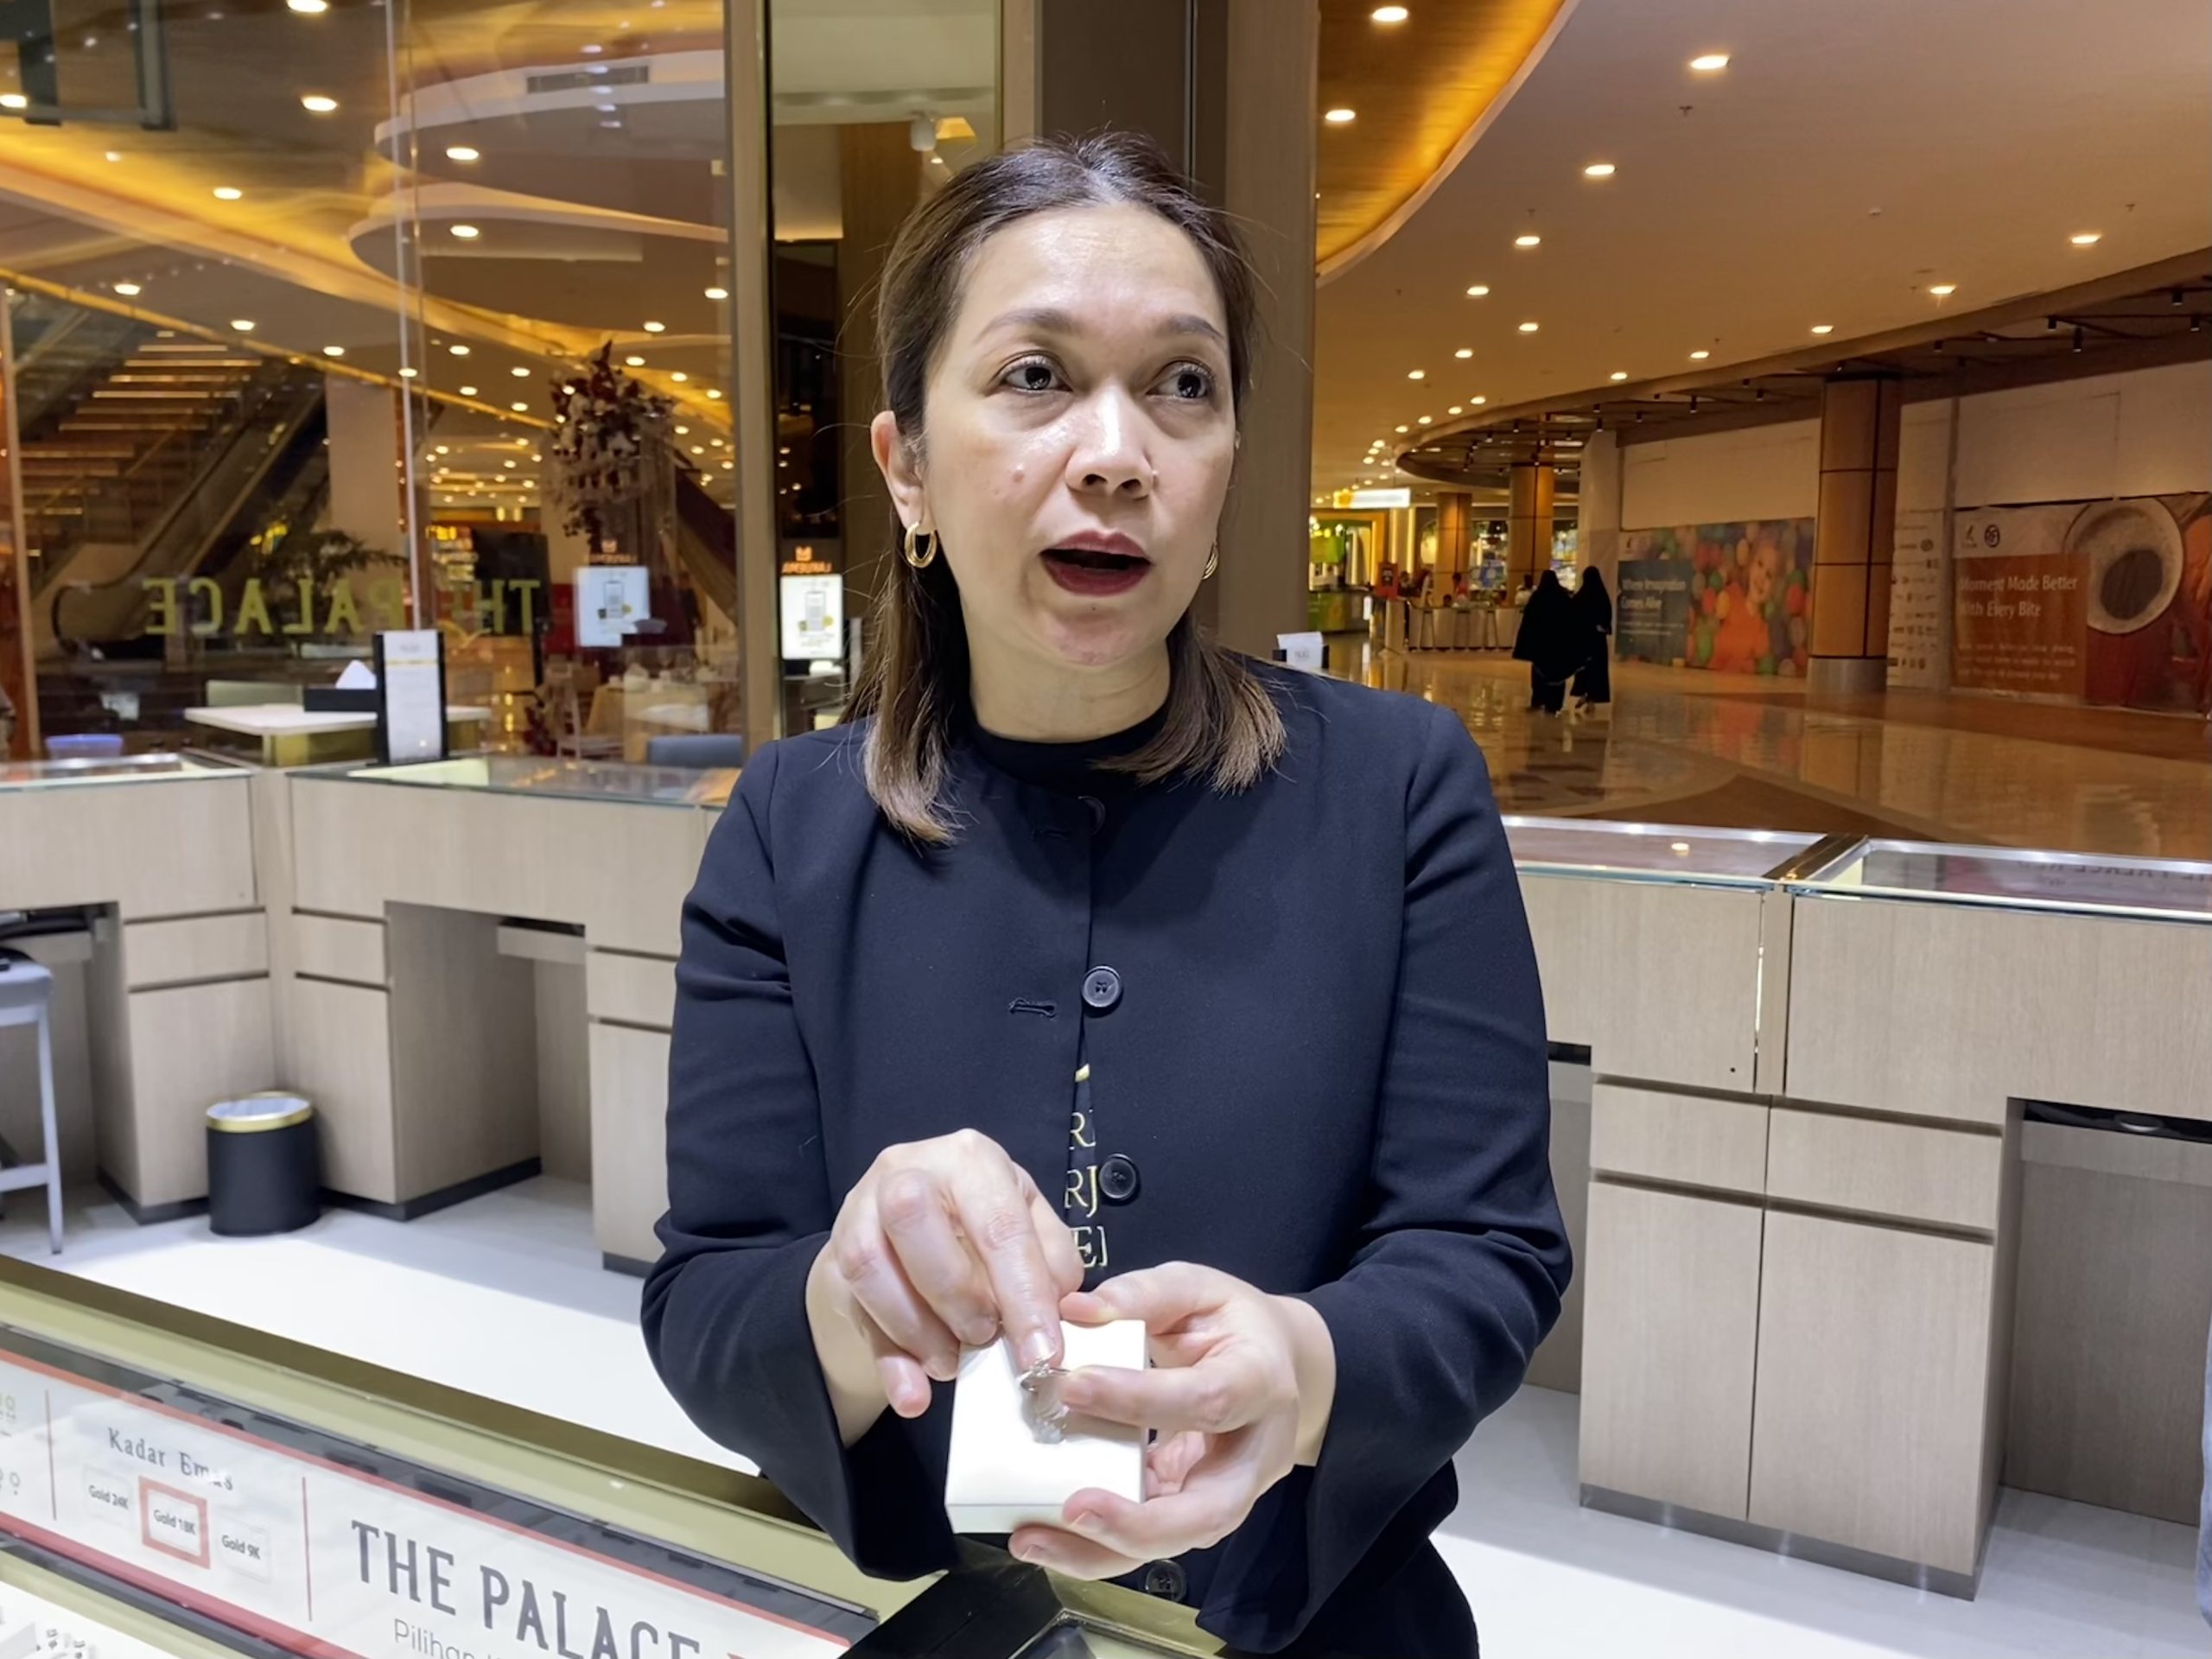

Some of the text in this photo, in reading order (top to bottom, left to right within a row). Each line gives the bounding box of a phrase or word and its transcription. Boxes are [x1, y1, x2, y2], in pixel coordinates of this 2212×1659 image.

[2008, 575, 2039, 590] Made
[2043, 575, 2077, 590] Better
[2018, 601, 2042, 616] Bite
[107, 1427, 166, 1467] Kadar
[88, 1484, 130, 1510] Gold 24K
[153, 1509, 196, 1535] Gold 18K
[221, 1535, 261, 1560] Gold 9K
[351, 1520, 457, 1617] THE
